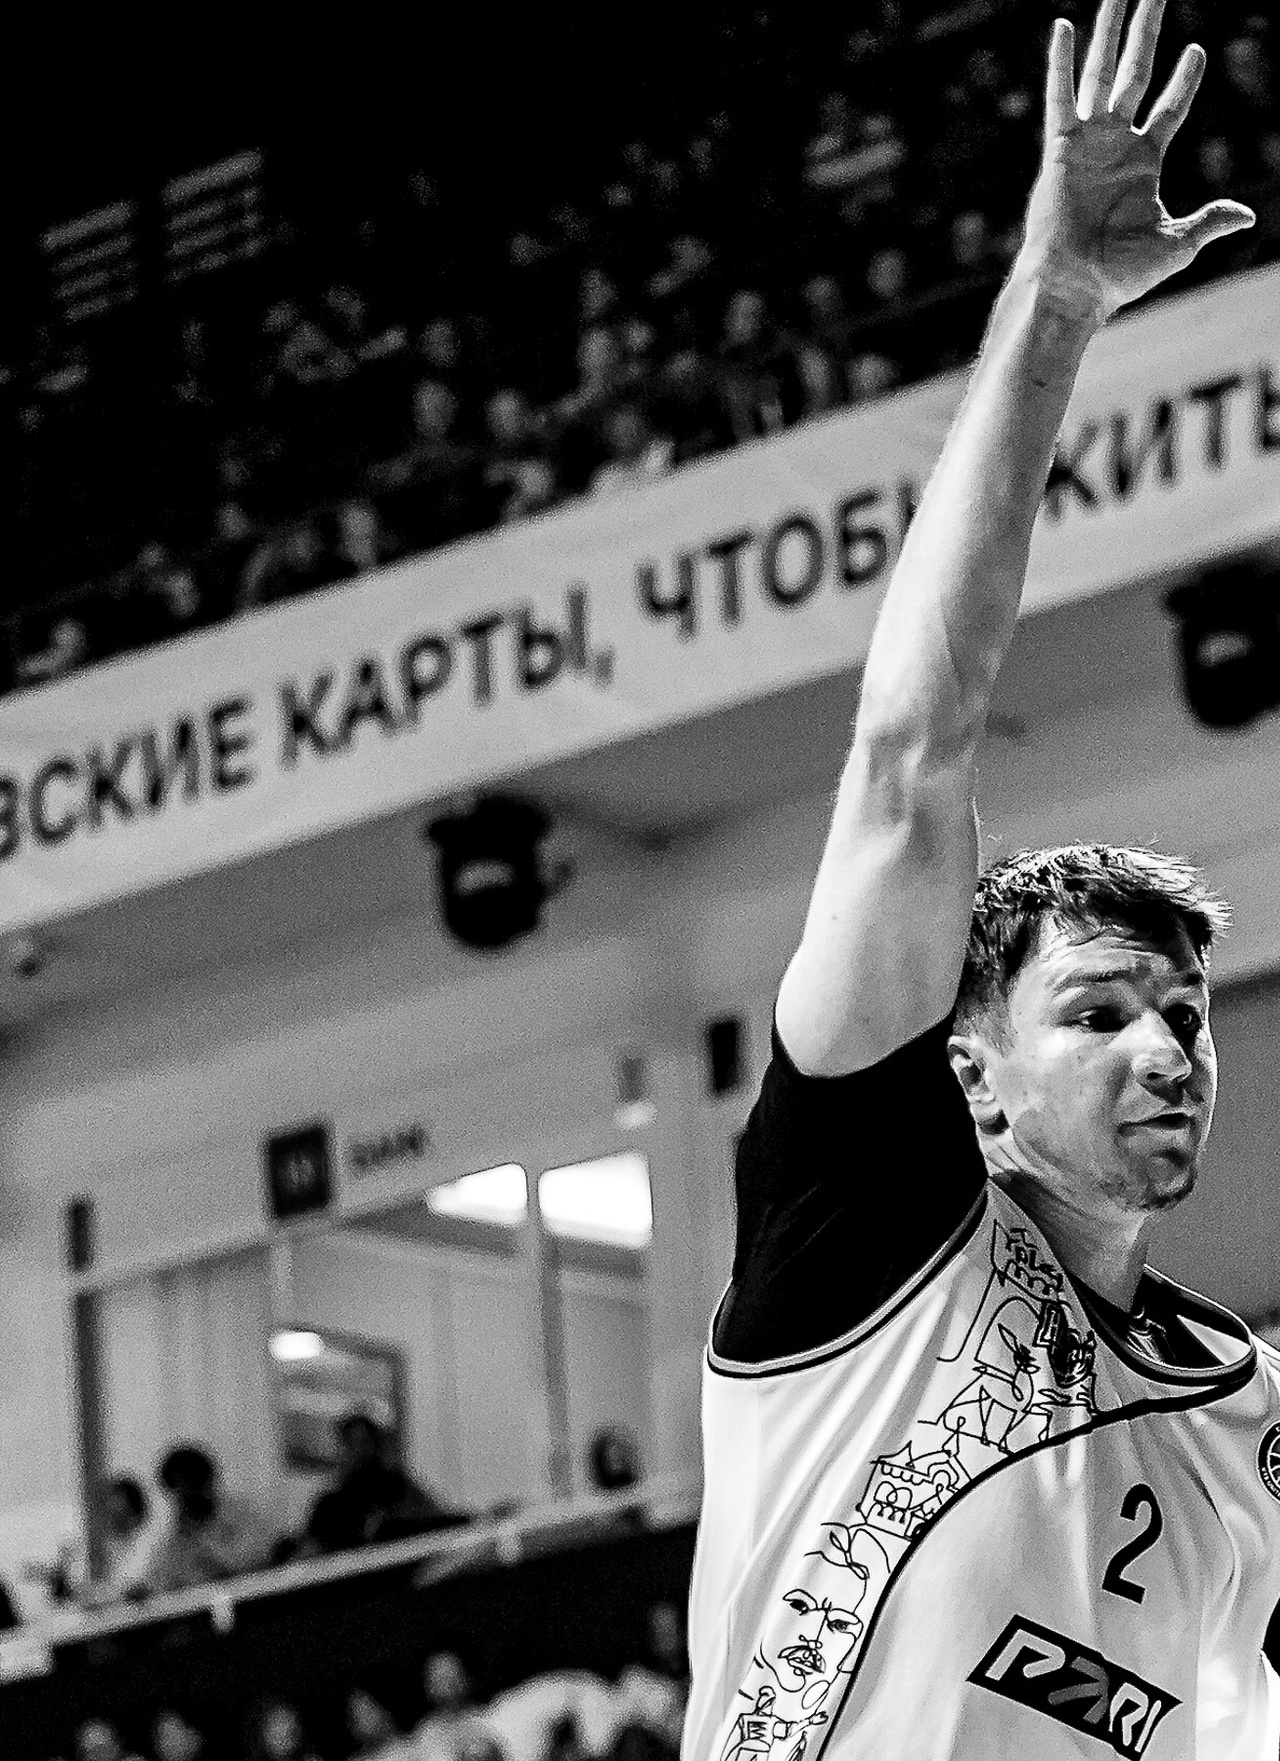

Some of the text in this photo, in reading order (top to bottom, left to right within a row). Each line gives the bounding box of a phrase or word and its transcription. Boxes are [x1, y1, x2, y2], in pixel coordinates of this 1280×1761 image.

[281, 583, 614, 768] КАРТЫ,
[636, 480, 919, 640] ЧТОБ
[1101, 1483, 1163, 1605] 2
